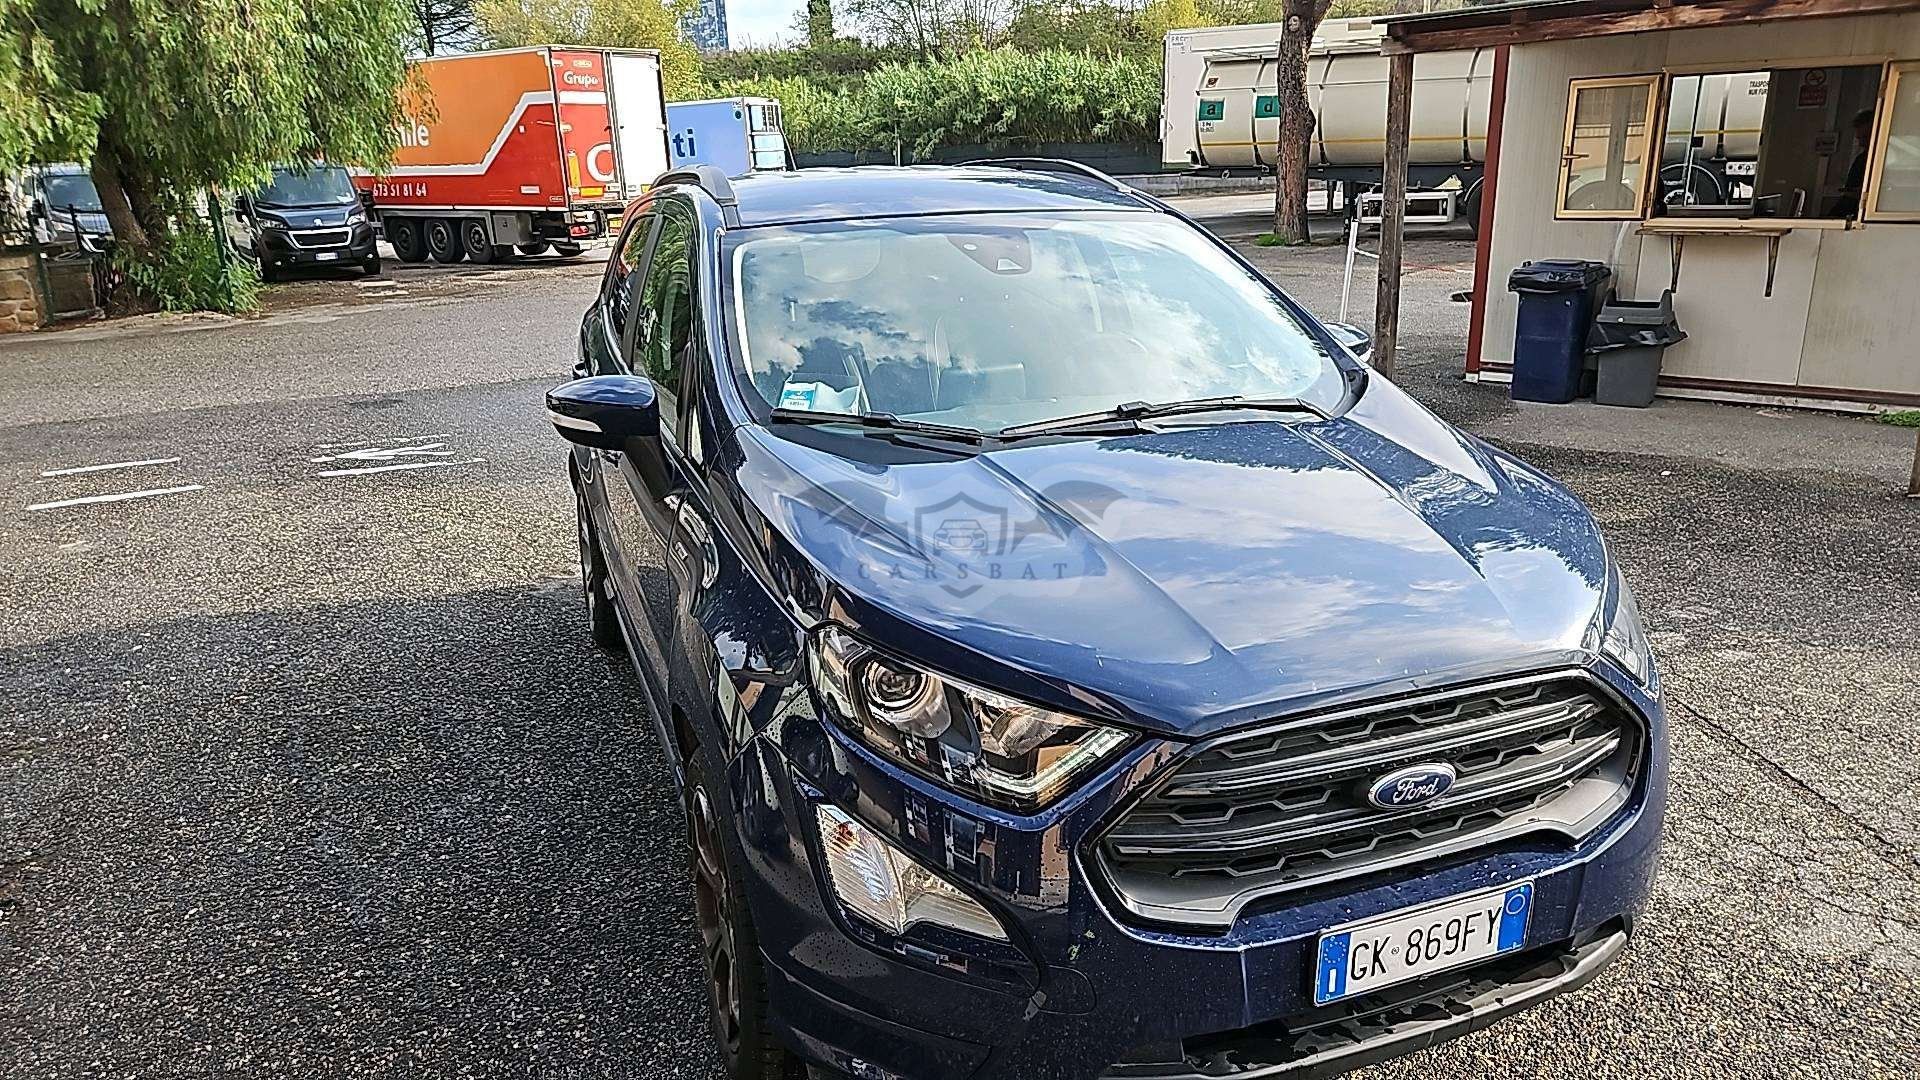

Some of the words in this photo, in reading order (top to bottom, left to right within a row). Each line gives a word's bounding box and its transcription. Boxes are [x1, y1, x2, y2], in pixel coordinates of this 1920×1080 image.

[563, 70, 599, 88] Grupo
[1206, 103, 1216, 115] a
[1264, 101, 1273, 113] d
[1392, 774, 1440, 804] Ford
[1351, 935, 1391, 981] GK
[1405, 905, 1503, 967] 869FY
